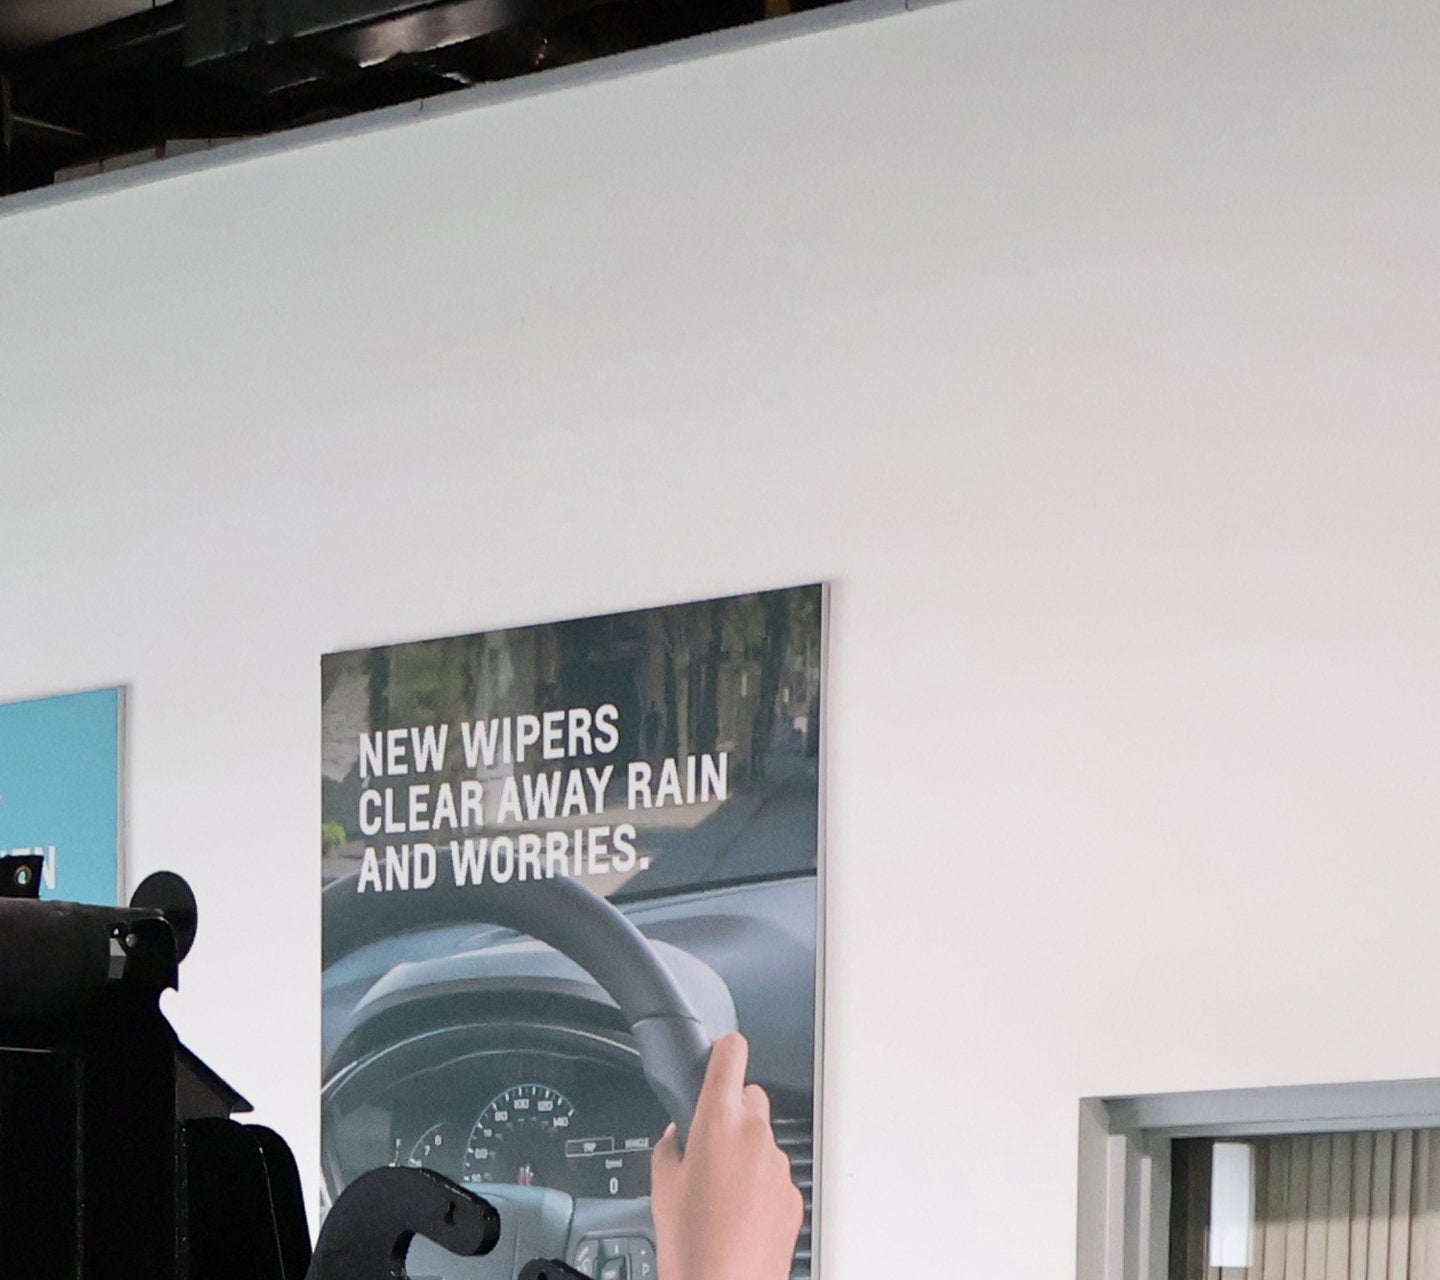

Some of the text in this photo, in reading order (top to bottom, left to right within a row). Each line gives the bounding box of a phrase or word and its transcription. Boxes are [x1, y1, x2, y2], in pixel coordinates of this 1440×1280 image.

[359, 703, 619, 778] NEW WIPERS
[358, 751, 729, 836] CLEAR AWAY RAIN
[356, 823, 650, 893] AND WORRIES.
